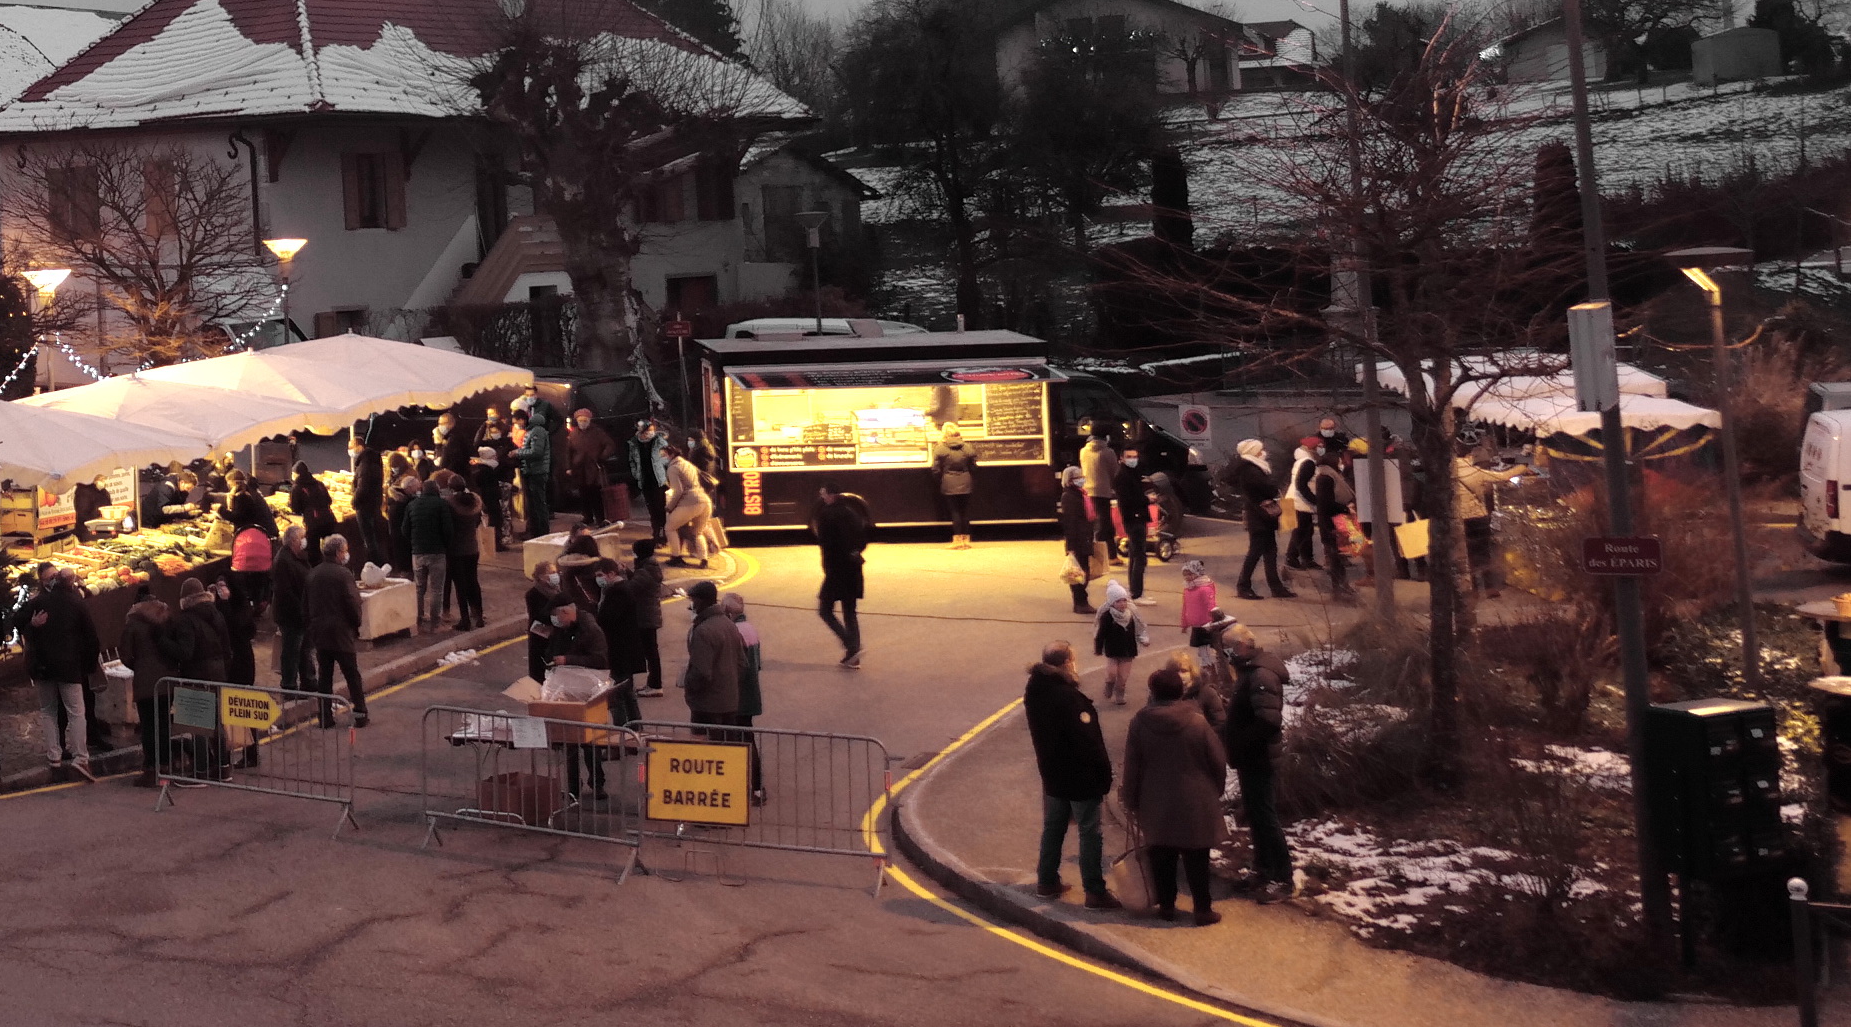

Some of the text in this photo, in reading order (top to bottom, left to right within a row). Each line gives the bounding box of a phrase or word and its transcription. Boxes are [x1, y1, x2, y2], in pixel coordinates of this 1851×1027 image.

[742, 472, 762, 515] BISTRO
[1604, 543, 1640, 553] Route
[1589, 556, 1658, 568] des ÉPARIS
[228, 695, 269, 710] DÉVIATION
[229, 708, 269, 721] PLEIN SUD
[670, 758, 725, 775] ROUTE
[663, 788, 731, 808] BARRÉE
